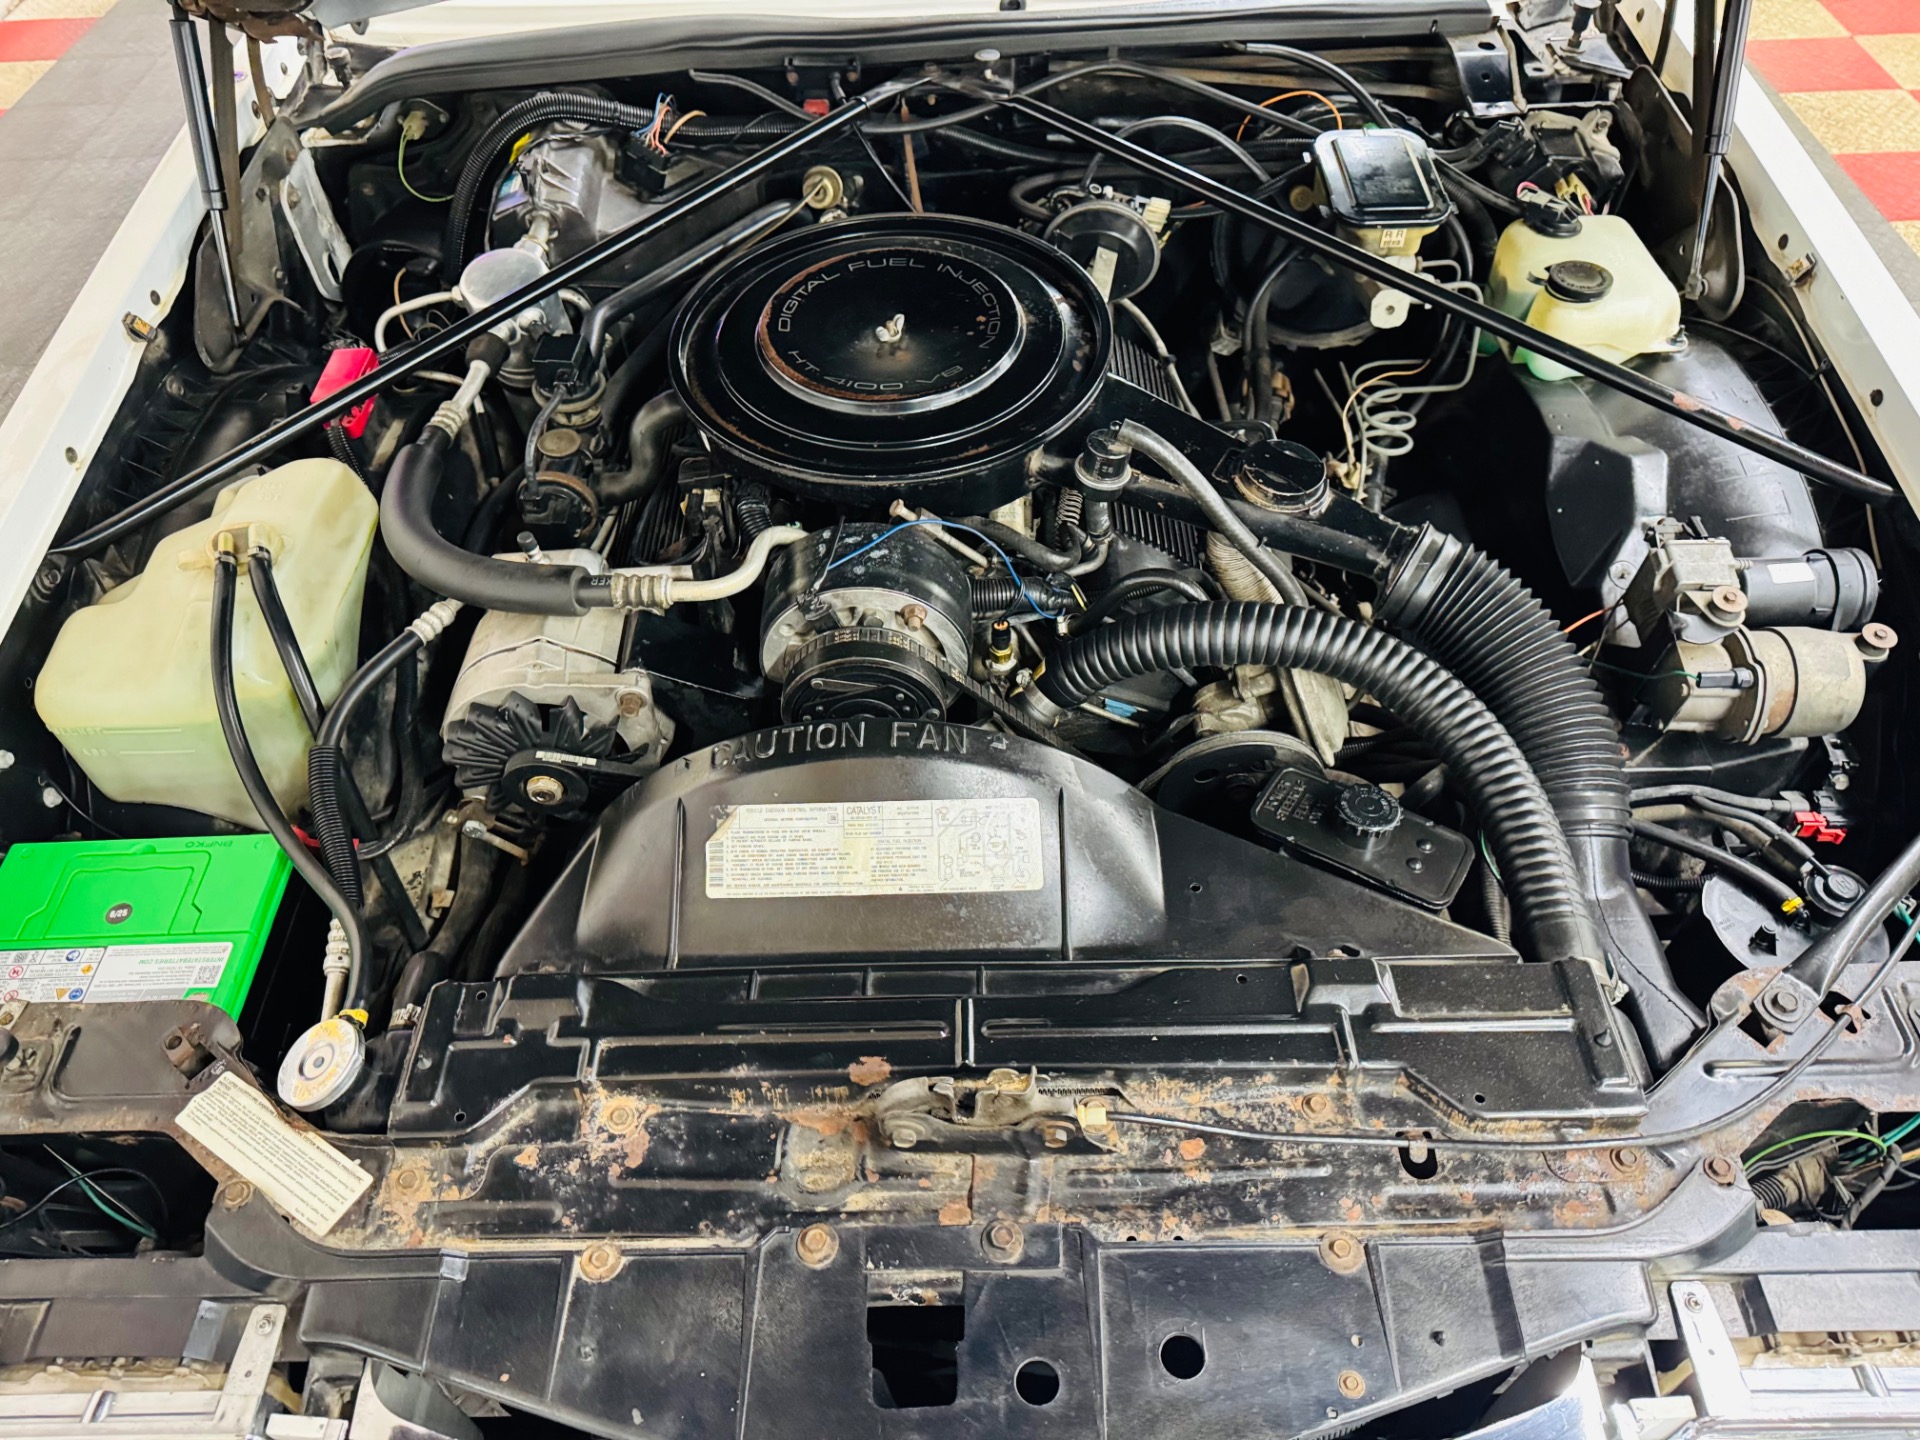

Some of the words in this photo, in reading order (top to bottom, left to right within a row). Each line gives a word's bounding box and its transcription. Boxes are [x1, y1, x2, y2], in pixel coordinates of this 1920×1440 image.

[778, 272, 840, 333] DIGITAL
[848, 257, 926, 271] FUEL
[937, 263, 1001, 349] INJECTION
[787, 350, 820, 373] HT
[823, 375, 904, 391] 4100
[916, 365, 964, 384] V8
[711, 721, 865, 769] CAUTION
[891, 721, 967, 754] FAN
[846, 805, 882, 815] CATALYST
[109, 908, 129, 919] 6/25
[138, 956, 224, 966] INTERSTATEBATTERIES.COM
